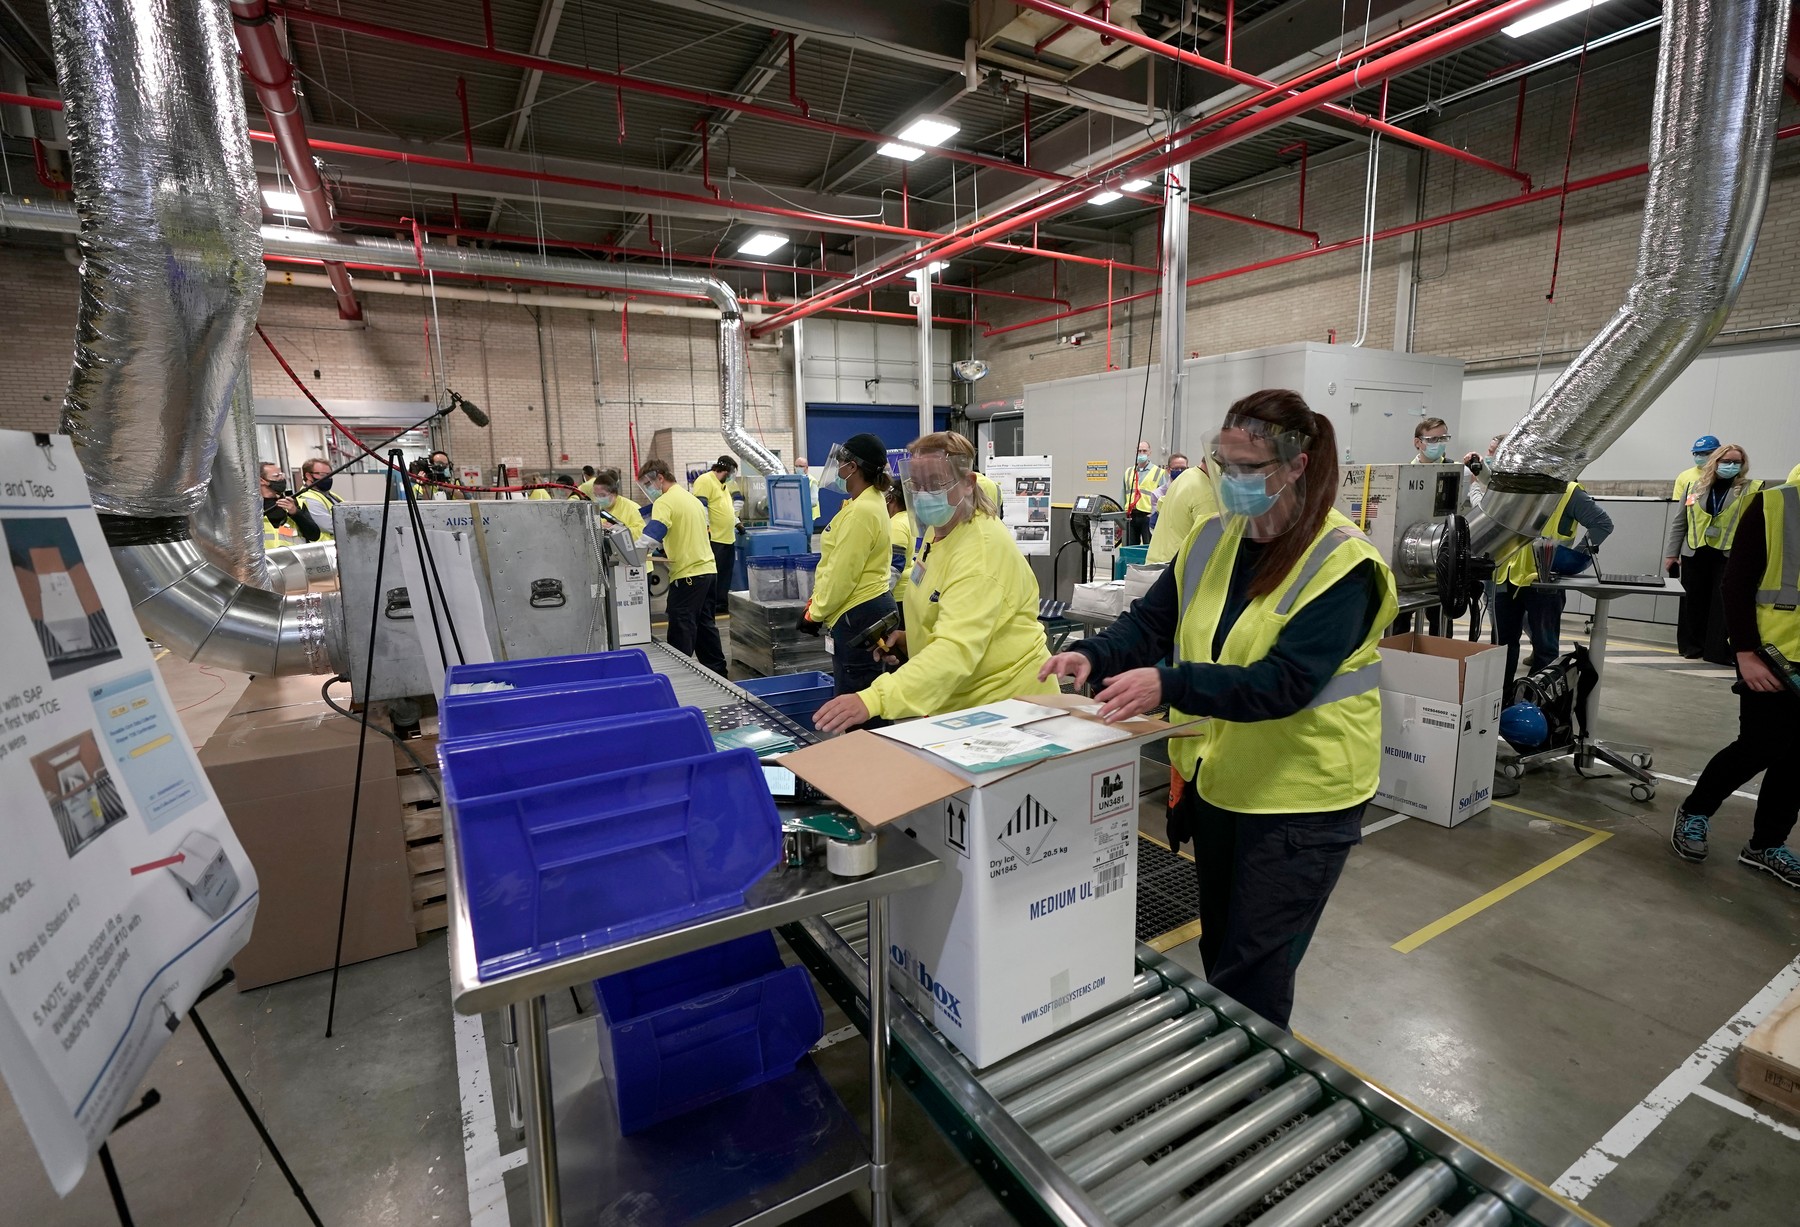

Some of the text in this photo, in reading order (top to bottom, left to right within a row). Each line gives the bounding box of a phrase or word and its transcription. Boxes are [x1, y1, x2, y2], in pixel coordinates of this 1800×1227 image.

[4, 479, 55, 502] and Tape
[1408, 479, 1425, 490] MIS
[445, 516, 490, 526] AUSTN
[22, 685, 43, 704] SAP
[22, 709, 40, 724] two
[39, 698, 61, 716] TOE
[1384, 746, 1427, 764] MEDIUM ULT
[1098, 795, 1125, 811] UN3481
[989, 855, 1015, 869] Dry Ice
[1043, 846, 1068, 859] 20.5 kg
[989, 863, 1018, 879] UN1845
[1030, 881, 1093, 921] MEDIUM UL
[45, 907, 69, 938] Station
[67, 892, 81, 913] #10
[113, 926, 129, 946] #10
[889, 944, 962, 1020] oftbox
[1020, 976, 1106, 1025] WWW.SOFTBOXSYSTEMS.COM
